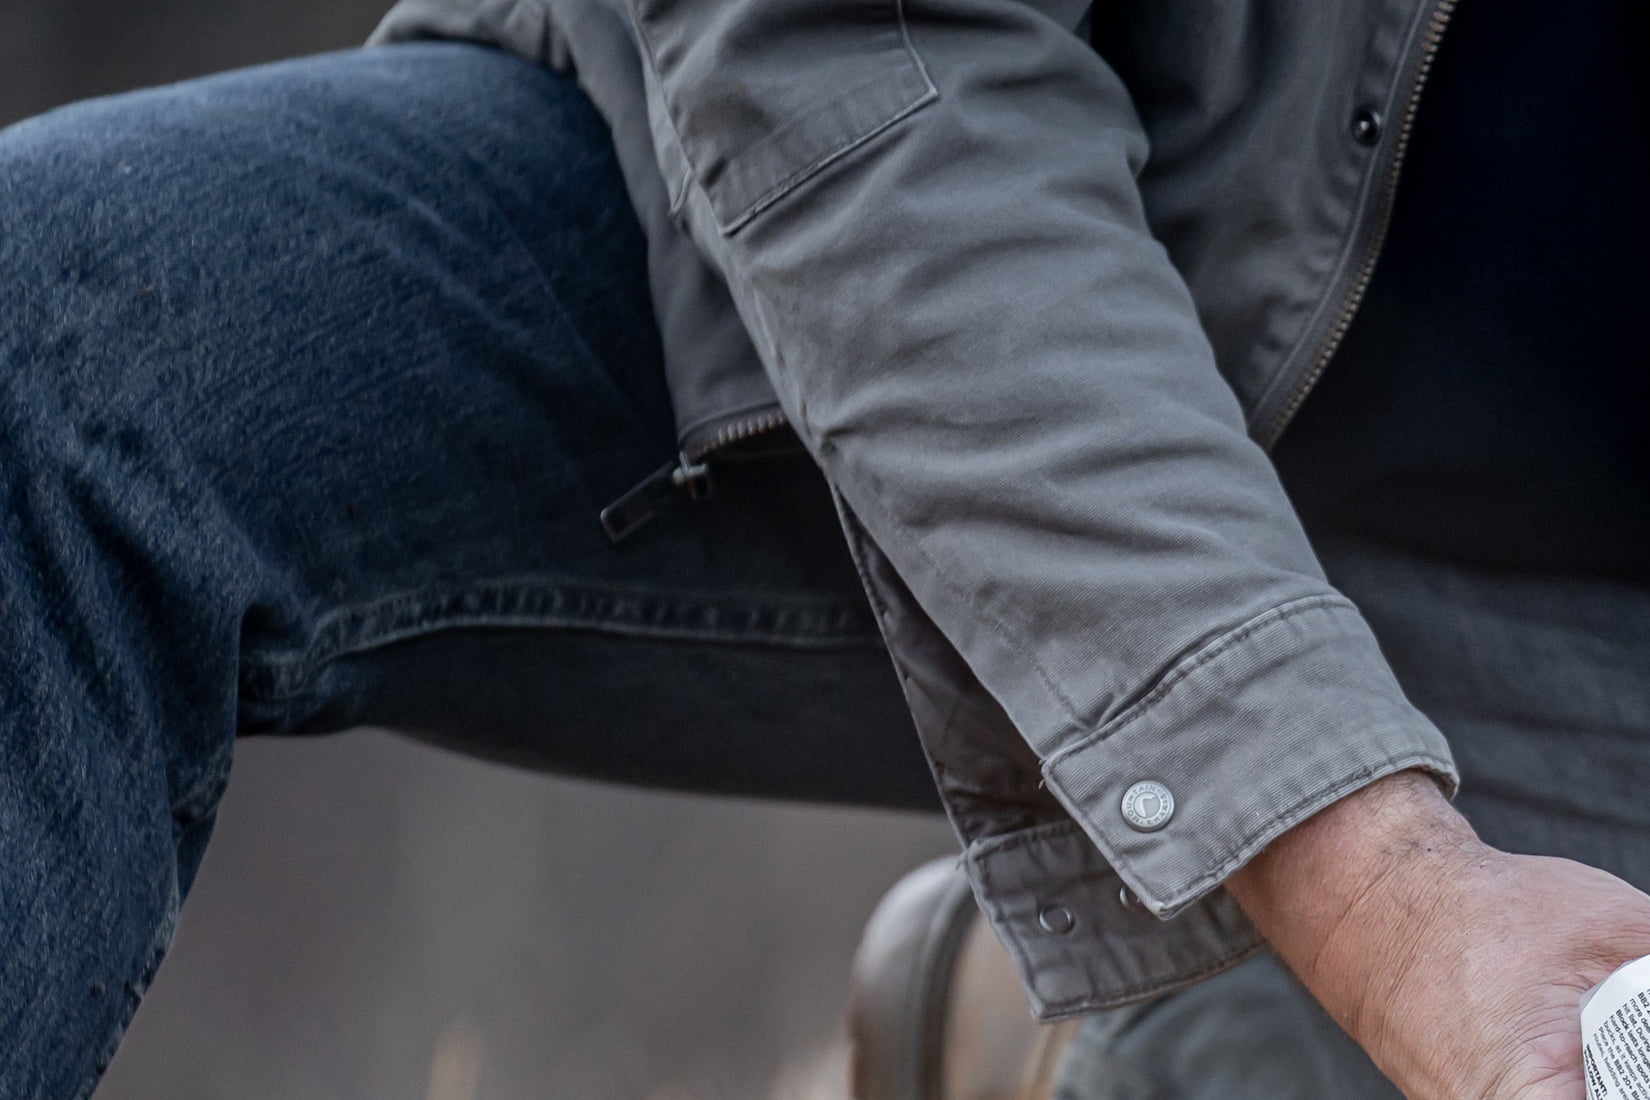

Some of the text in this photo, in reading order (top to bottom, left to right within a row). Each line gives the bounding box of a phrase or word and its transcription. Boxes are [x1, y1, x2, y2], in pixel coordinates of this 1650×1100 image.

[1622, 1003, 1631, 1015] hit
[1630, 998, 1643, 1017] more
[1637, 992, 1650, 1008] BB2
[1616, 1009, 1629, 1031] Block
[1627, 1029, 1639, 1048] lasts
[1598, 1026, 1609, 1047] Place
[1607, 1046, 1615, 1060] the
[1614, 1059, 1625, 1075] BB2
[1622, 1075, 1633, 1090] 20+
[1609, 1014, 1638, 1063] hard-to-reach
[1636, 1063, 1650, 1084] spots
[1615, 1045, 1622, 1054] as
[1624, 1059, 1638, 1082] keeps
[1603, 1056, 1621, 1088] bedding
